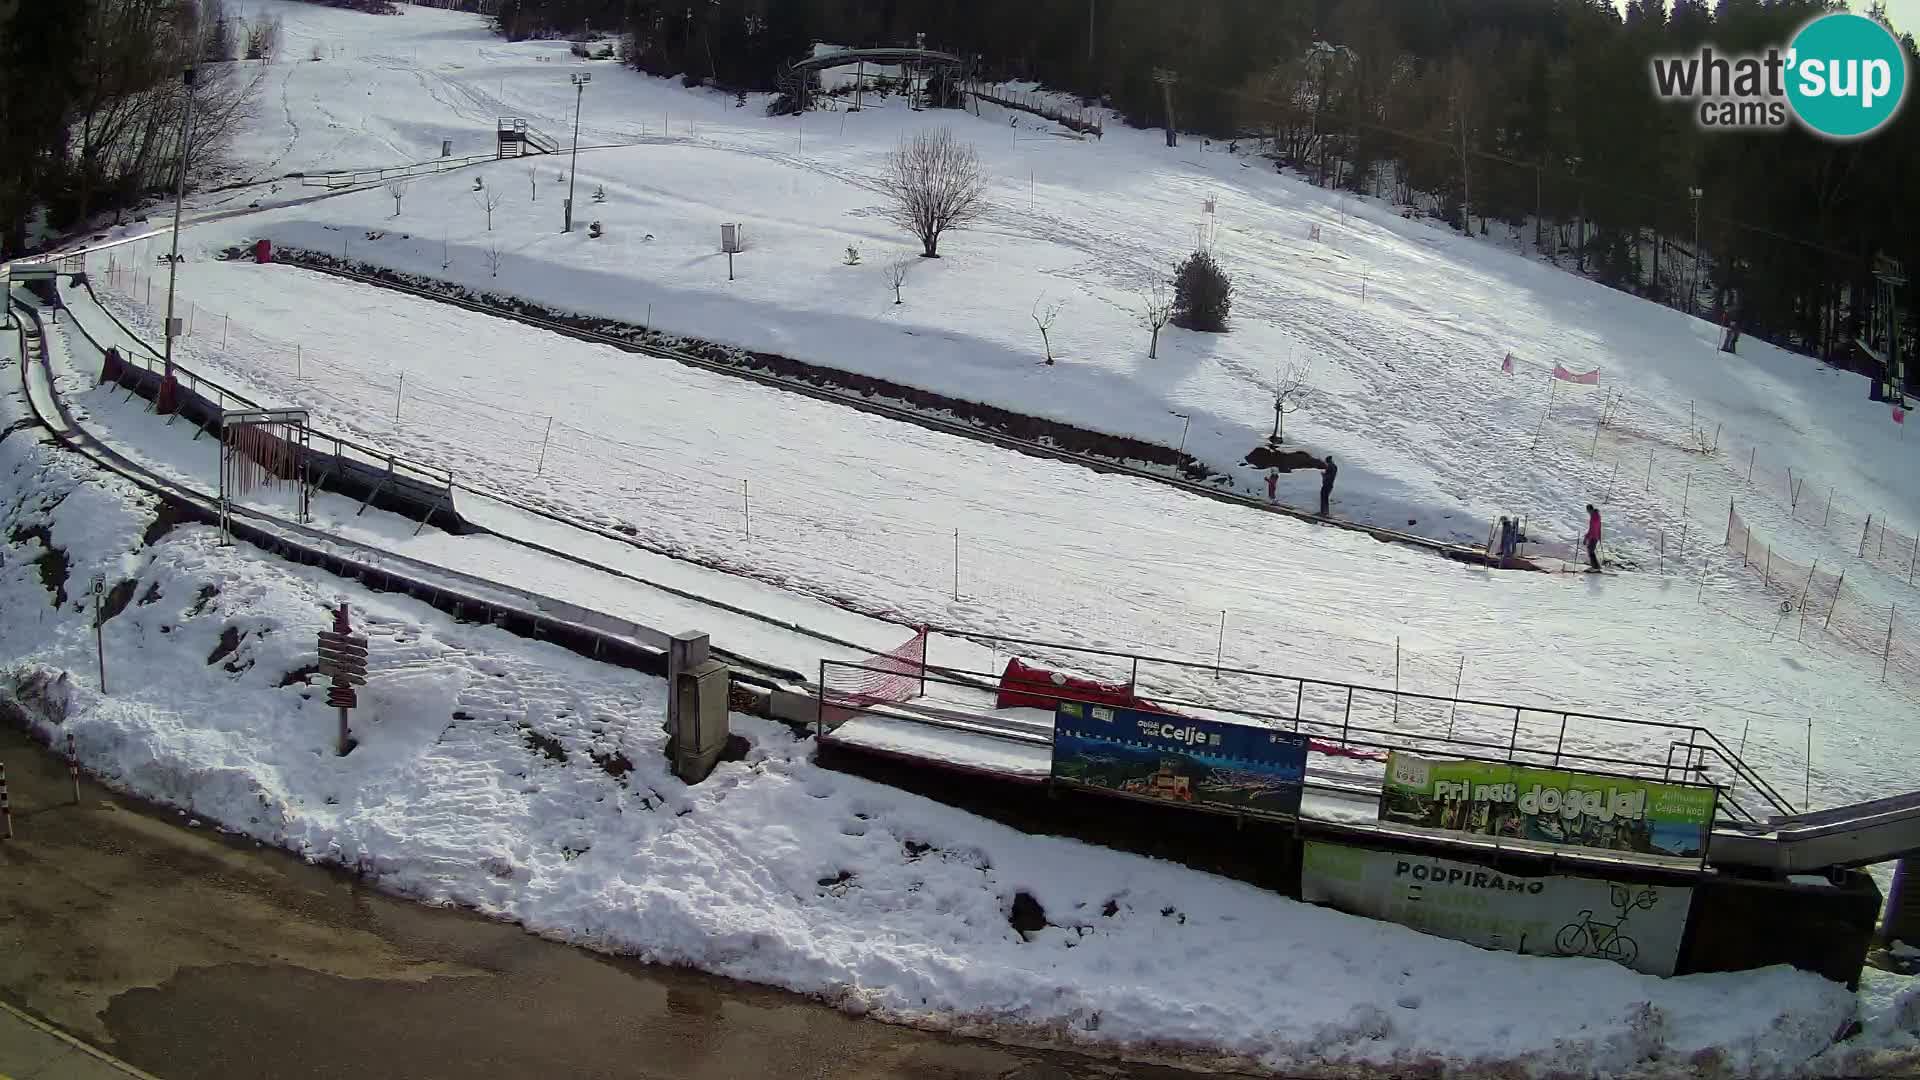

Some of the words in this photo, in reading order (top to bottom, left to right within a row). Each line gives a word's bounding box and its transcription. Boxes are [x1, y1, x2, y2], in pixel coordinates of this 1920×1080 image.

[1143, 727, 1160, 737] Visit
[1161, 723, 1207, 746] Celje
[1434, 779, 1469, 801] Pri
[1474, 782, 1516, 803] nas
[1519, 784, 1648, 822] dogaja!
[1396, 860, 1544, 895] PODPIRAMO
